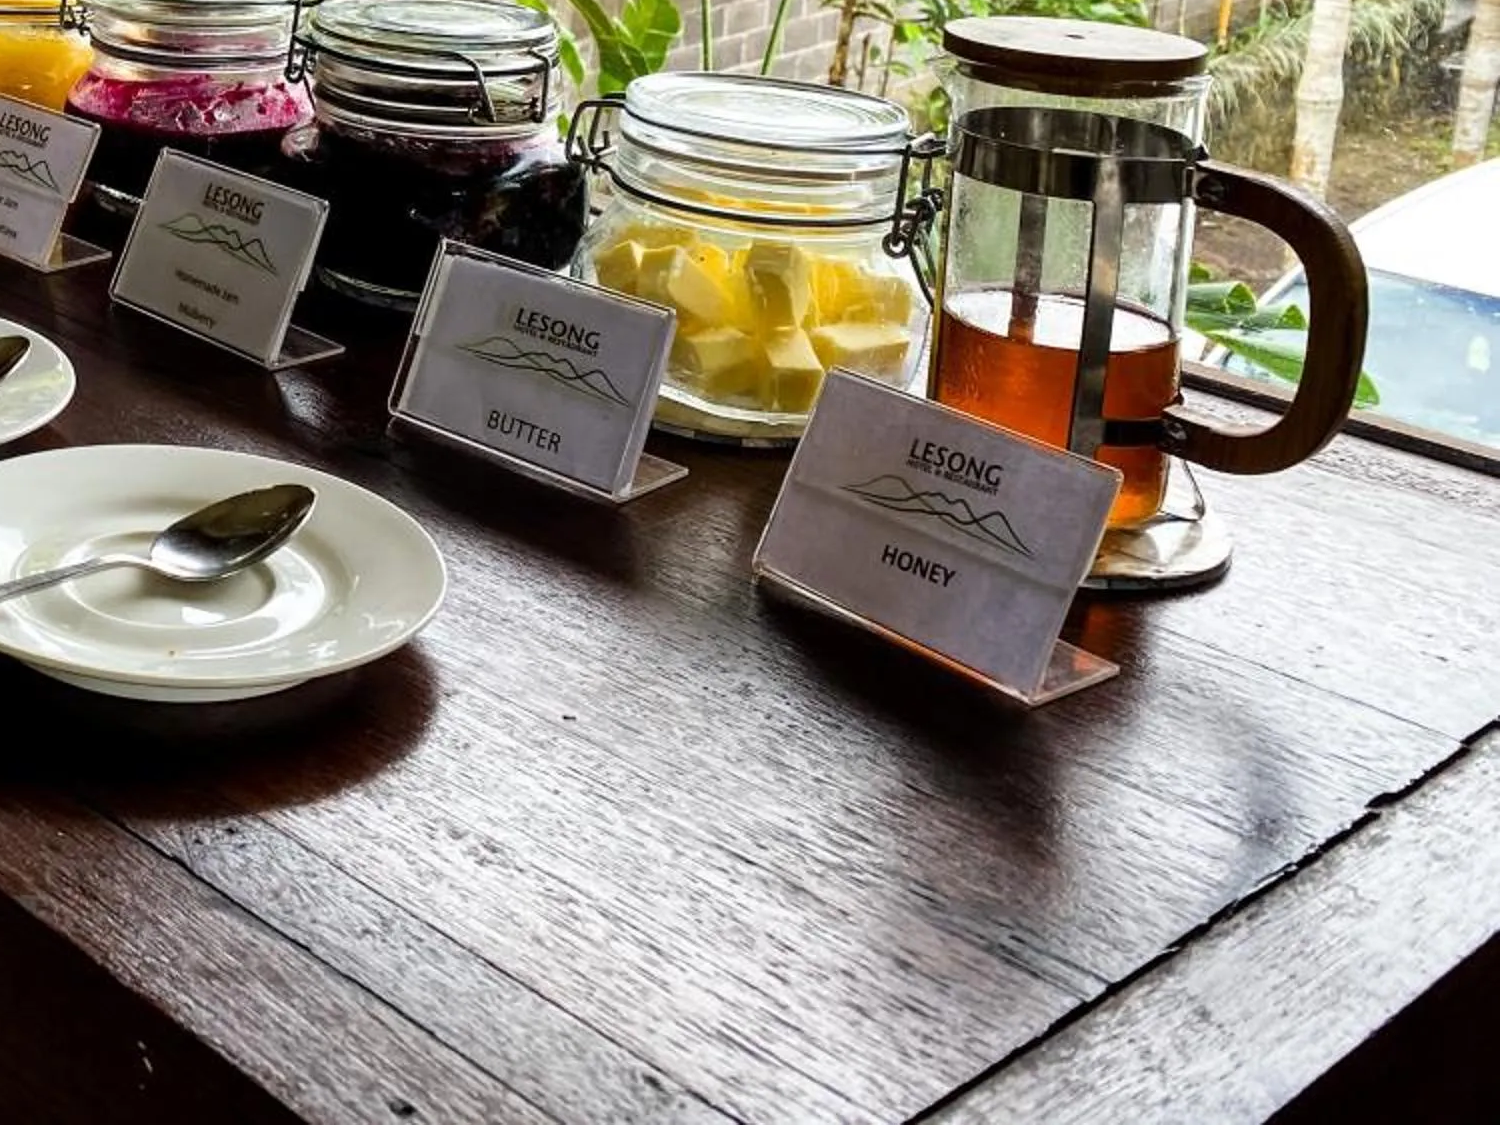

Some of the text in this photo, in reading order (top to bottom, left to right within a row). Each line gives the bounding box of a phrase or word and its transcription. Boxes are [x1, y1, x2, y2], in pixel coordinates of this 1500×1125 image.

[0, 112, 51, 143] LESONG
[204, 182, 265, 220] LESONG
[516, 307, 601, 350] LESONG
[486, 409, 561, 453] BUTTER
[908, 437, 1004, 486] LESONG
[880, 543, 957, 588] HONEY
